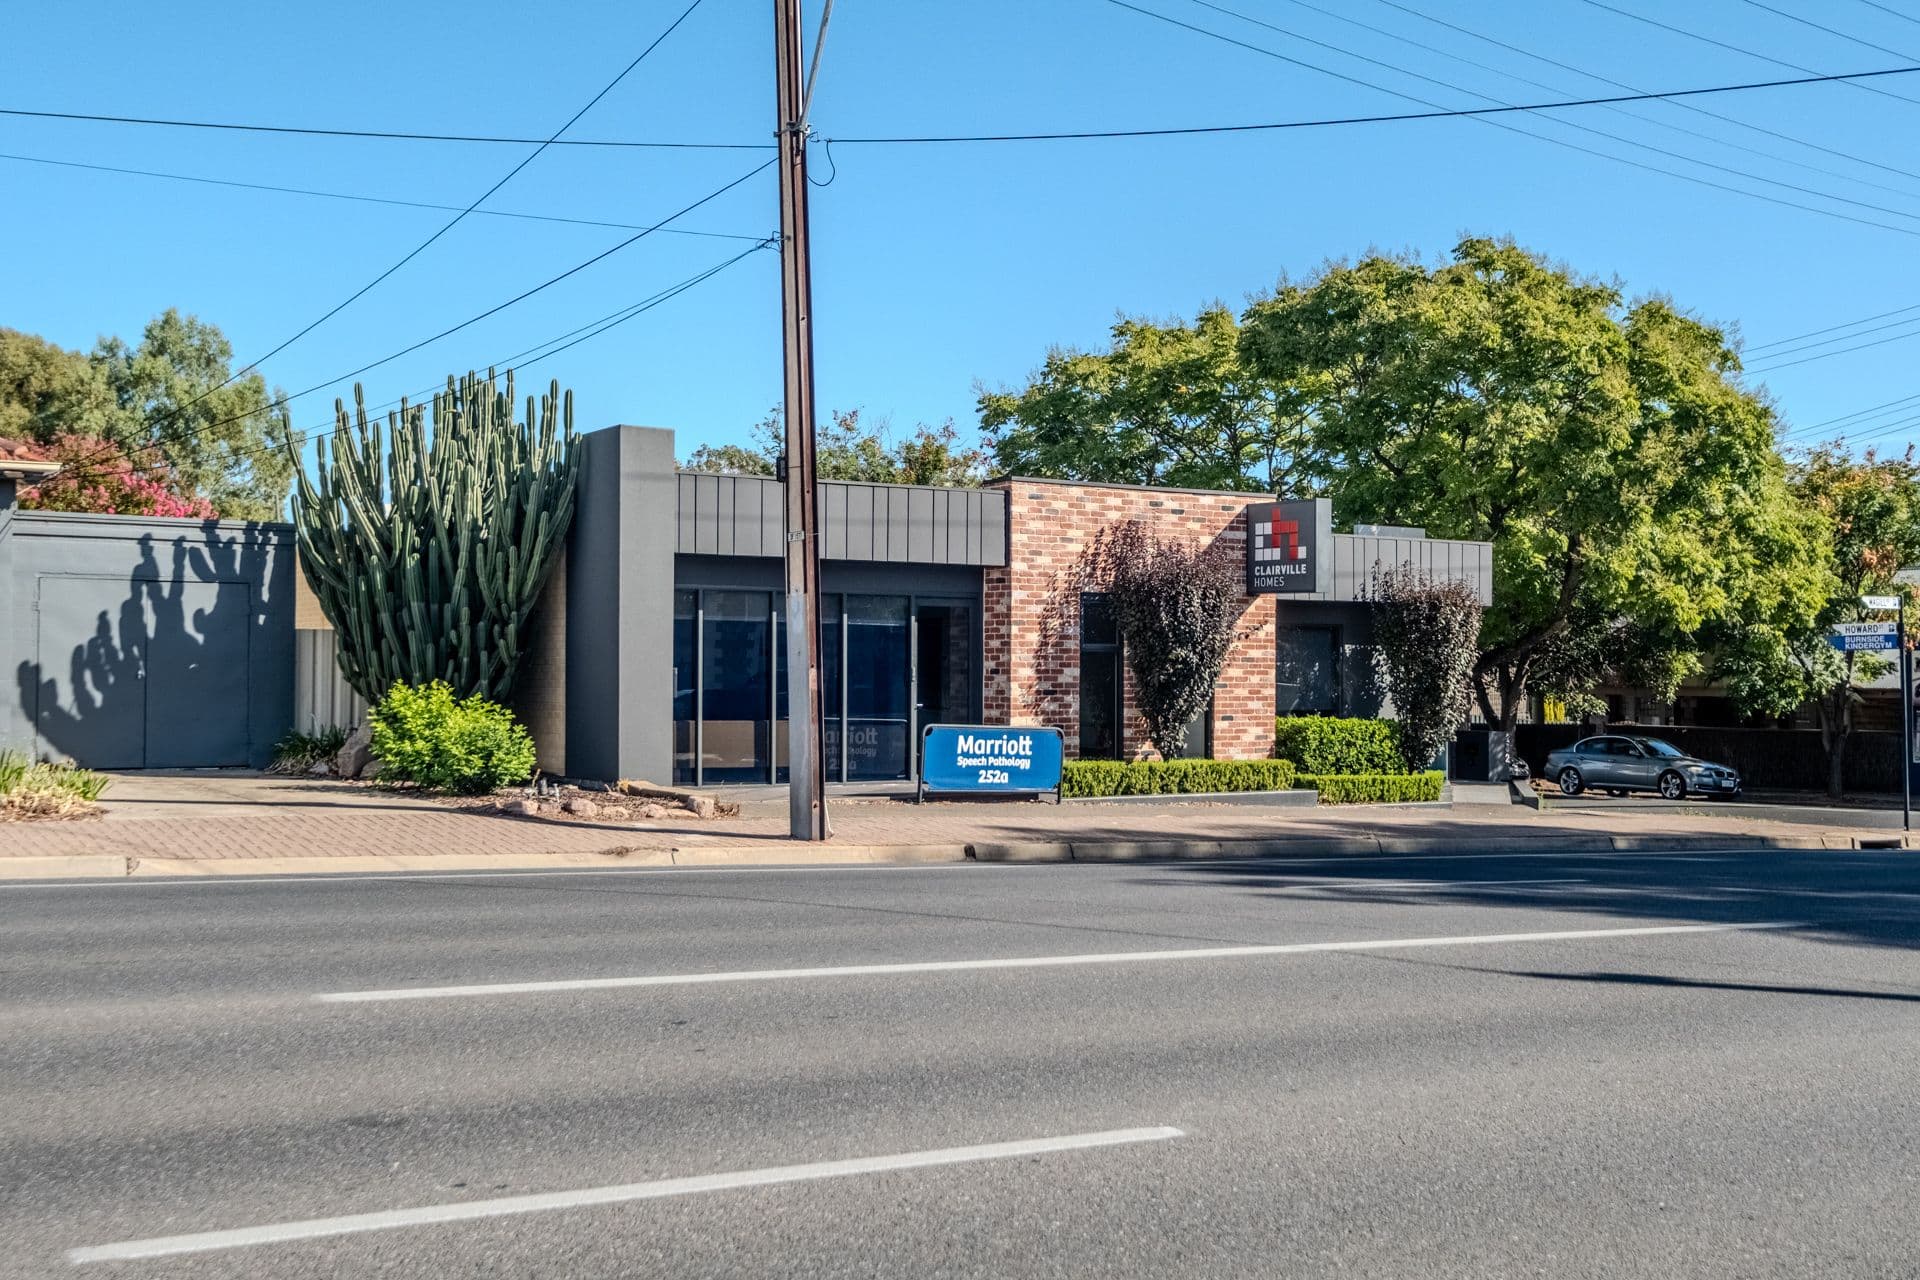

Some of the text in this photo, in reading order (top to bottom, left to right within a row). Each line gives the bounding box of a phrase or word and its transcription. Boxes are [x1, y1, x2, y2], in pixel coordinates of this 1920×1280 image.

[1254, 564, 1307, 576] CLAIRVILLE
[1254, 577, 1285, 587] HOMES
[1845, 624, 1878, 634] HOWARD
[1845, 635, 1885, 643] BURNSIDE
[957, 734, 1032, 755] Marriott
[956, 756, 1031, 770] Speech Pathology
[978, 770, 1009, 784] 252a
